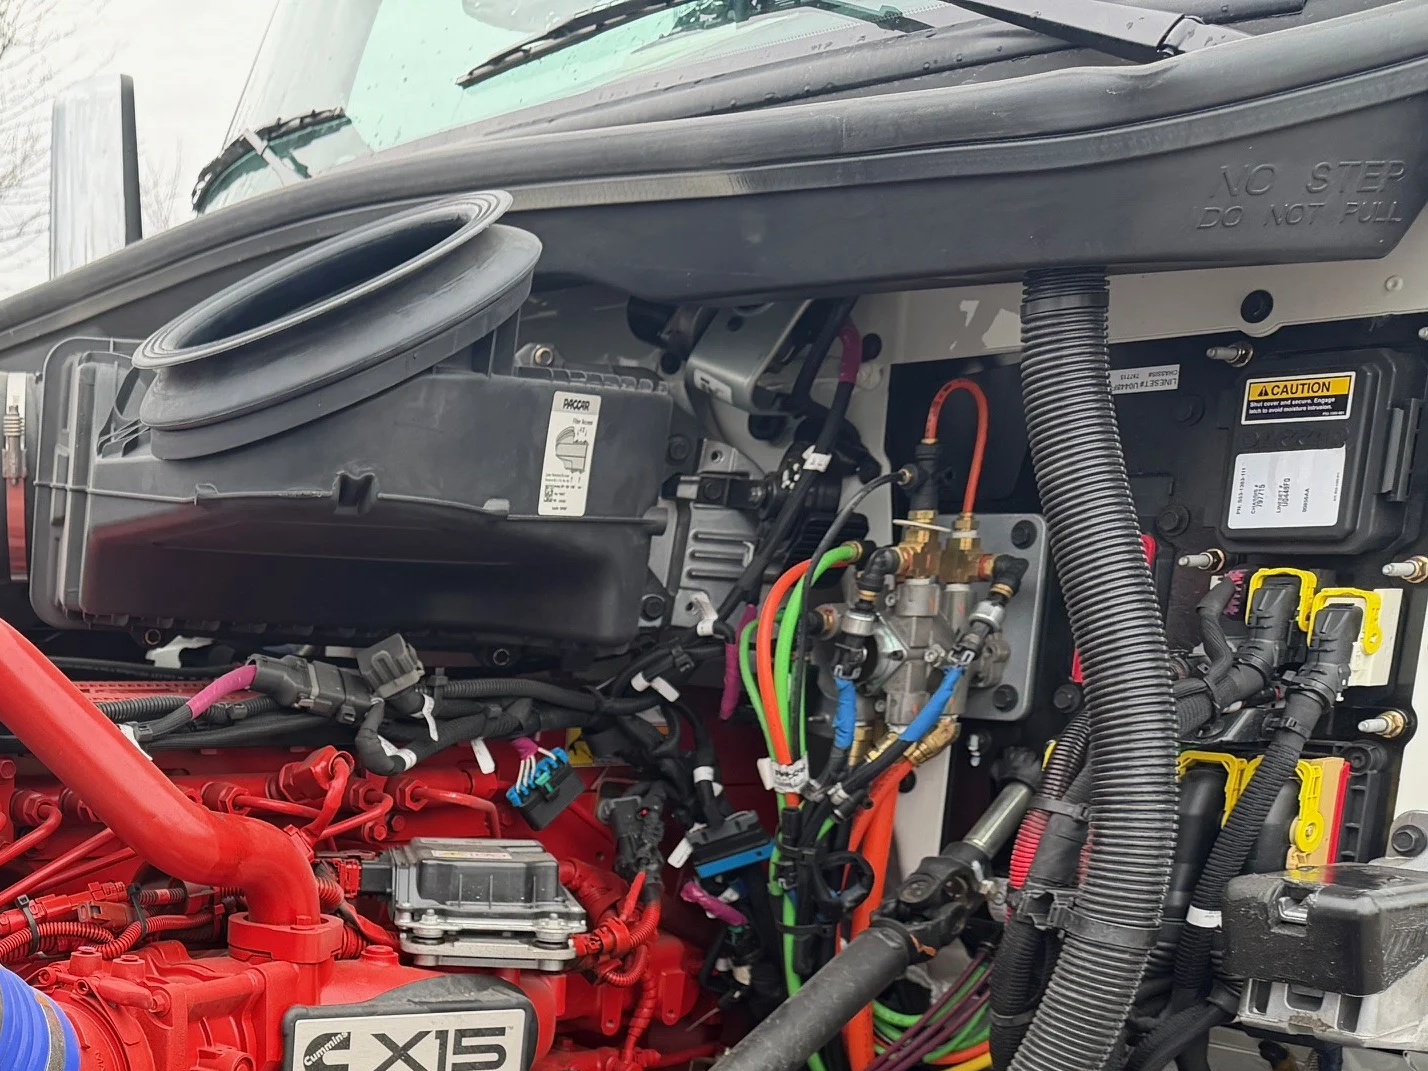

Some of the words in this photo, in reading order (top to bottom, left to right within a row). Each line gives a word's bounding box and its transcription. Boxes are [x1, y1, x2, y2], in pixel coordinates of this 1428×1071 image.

[1210, 163, 1276, 198] NO
[1306, 160, 1406, 194] STEP
[1197, 205, 1243, 229] DO
[1263, 202, 1325, 227] NOT
[1340, 201, 1403, 223] PULL
[1271, 381, 1331, 395] CAUTION
[563, 398, 590, 411] PACCAR
[304, 1031, 349, 1067] Cummins
